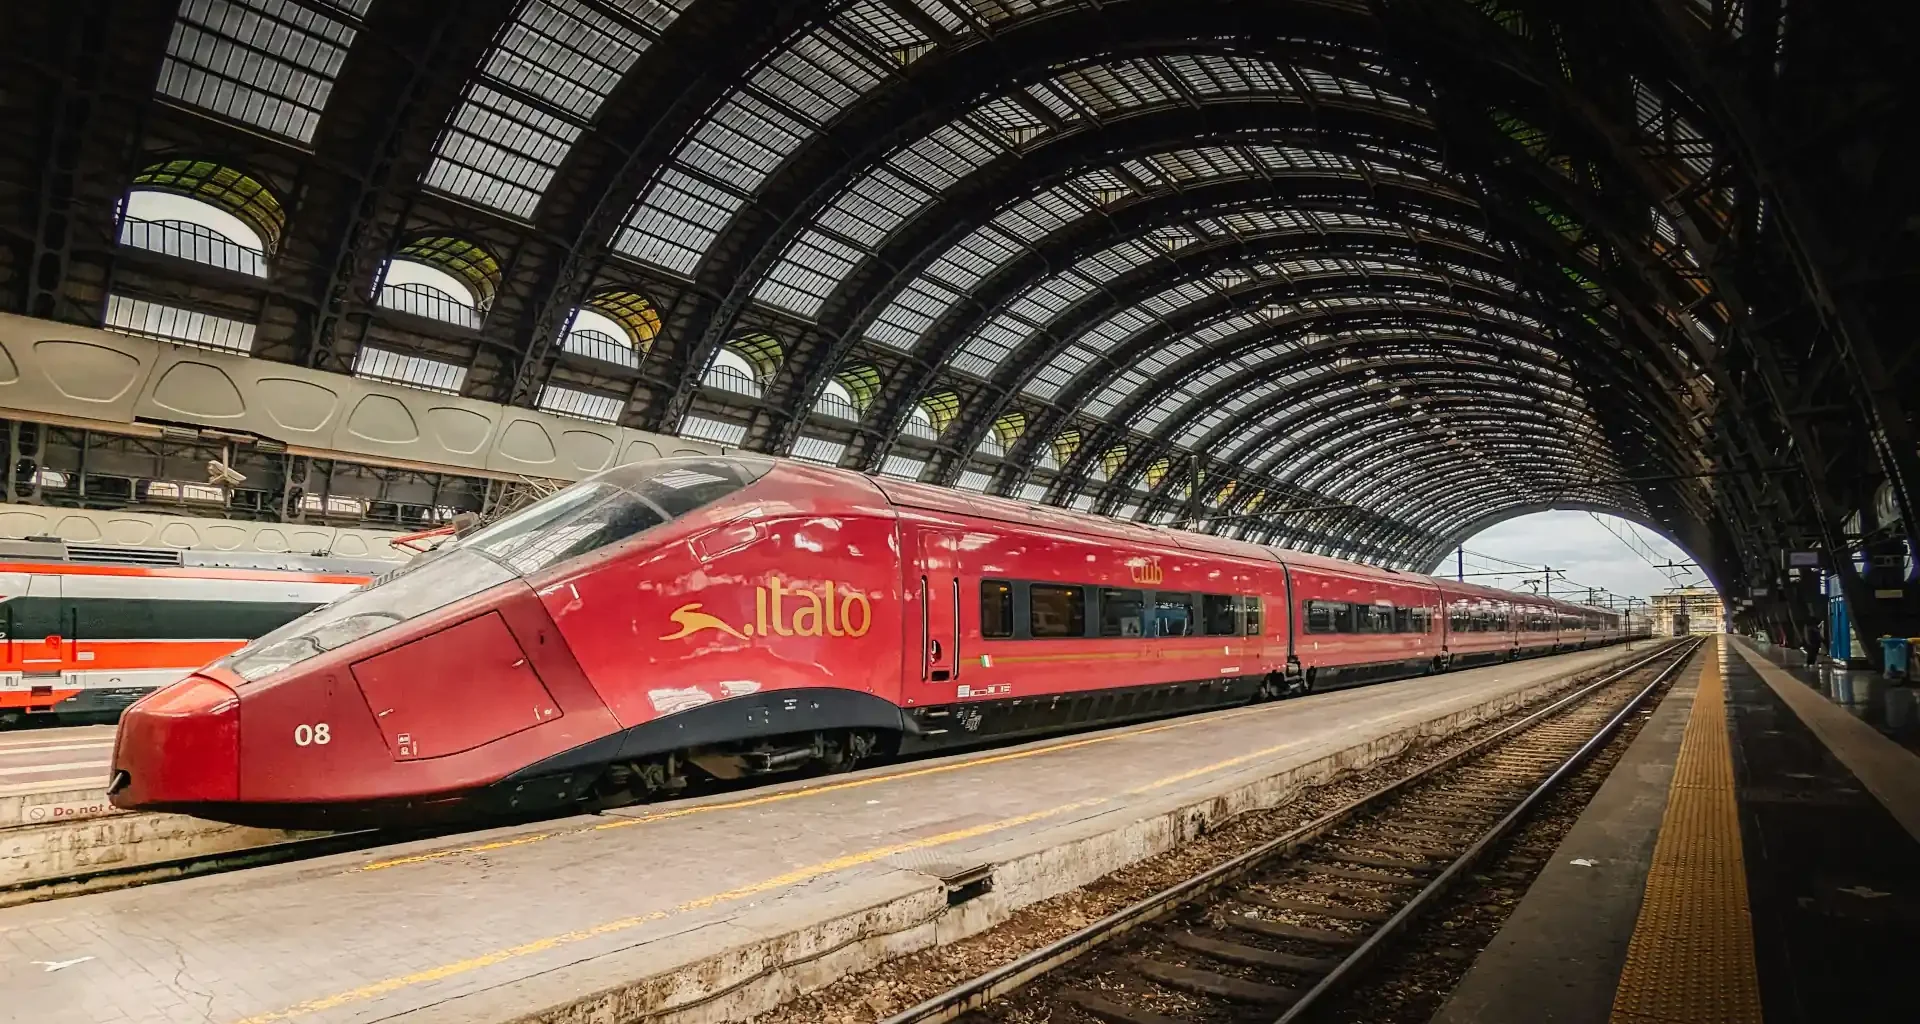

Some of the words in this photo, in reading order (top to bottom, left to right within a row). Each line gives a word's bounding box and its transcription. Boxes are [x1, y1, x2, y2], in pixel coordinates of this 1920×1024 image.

[294, 723, 331, 746] 08
[54, 807, 74, 817] Do
[80, 803, 103, 814] not
